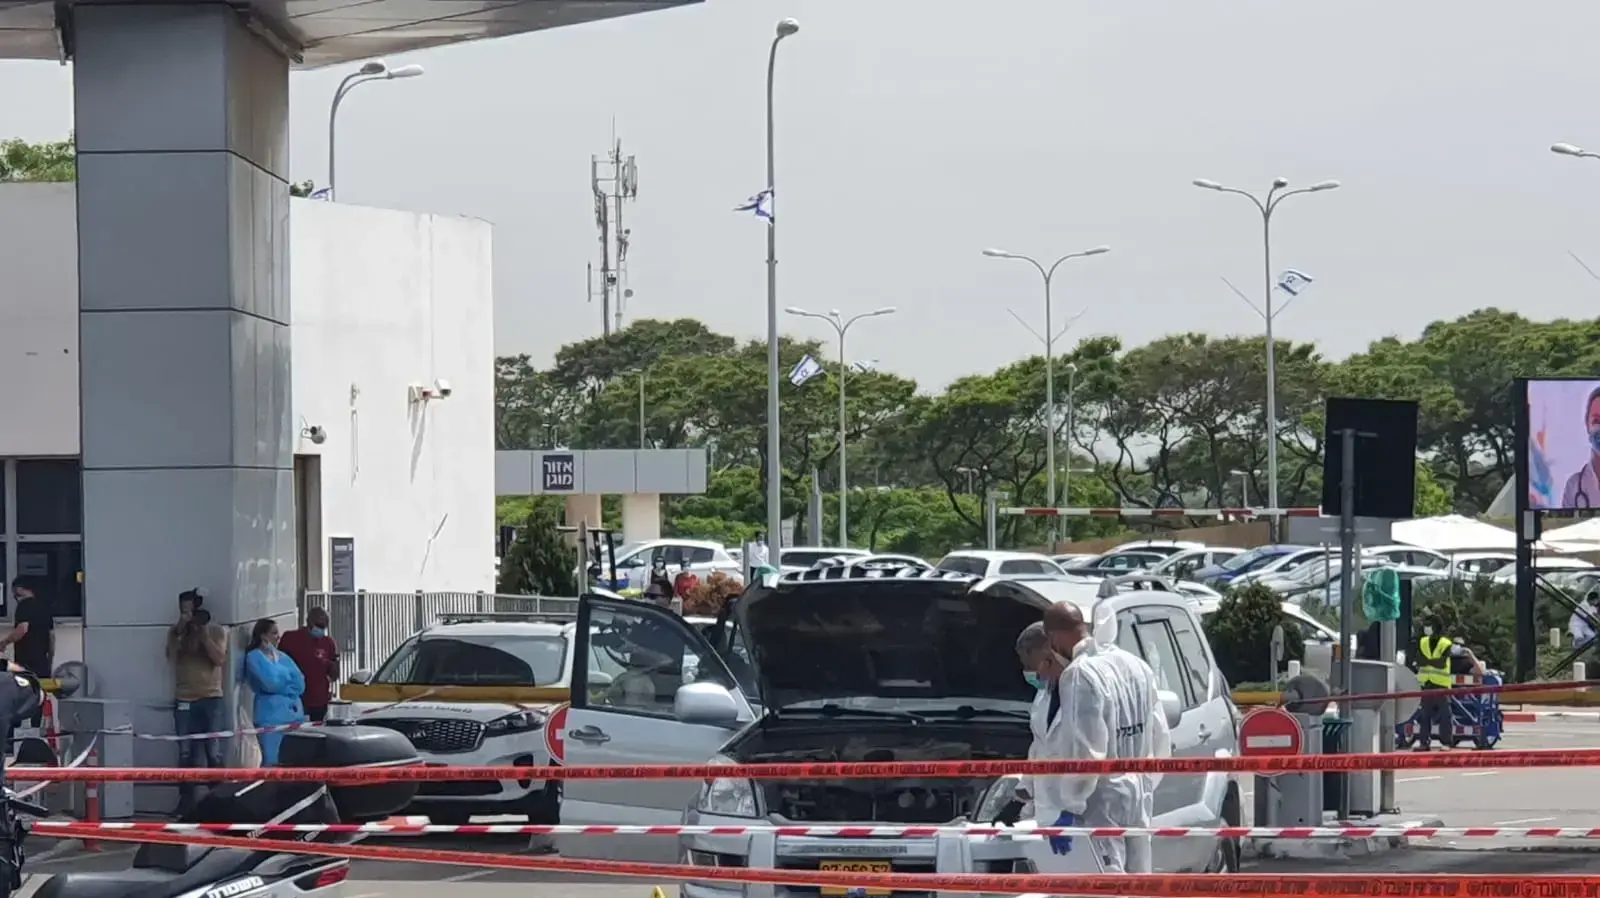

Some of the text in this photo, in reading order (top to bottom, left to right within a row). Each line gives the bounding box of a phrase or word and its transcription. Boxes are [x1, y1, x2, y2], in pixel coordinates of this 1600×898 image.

[544, 460, 573, 473] אזור
[546, 473, 573, 488] מוגן
[206, 875, 265, 898] משטרה
